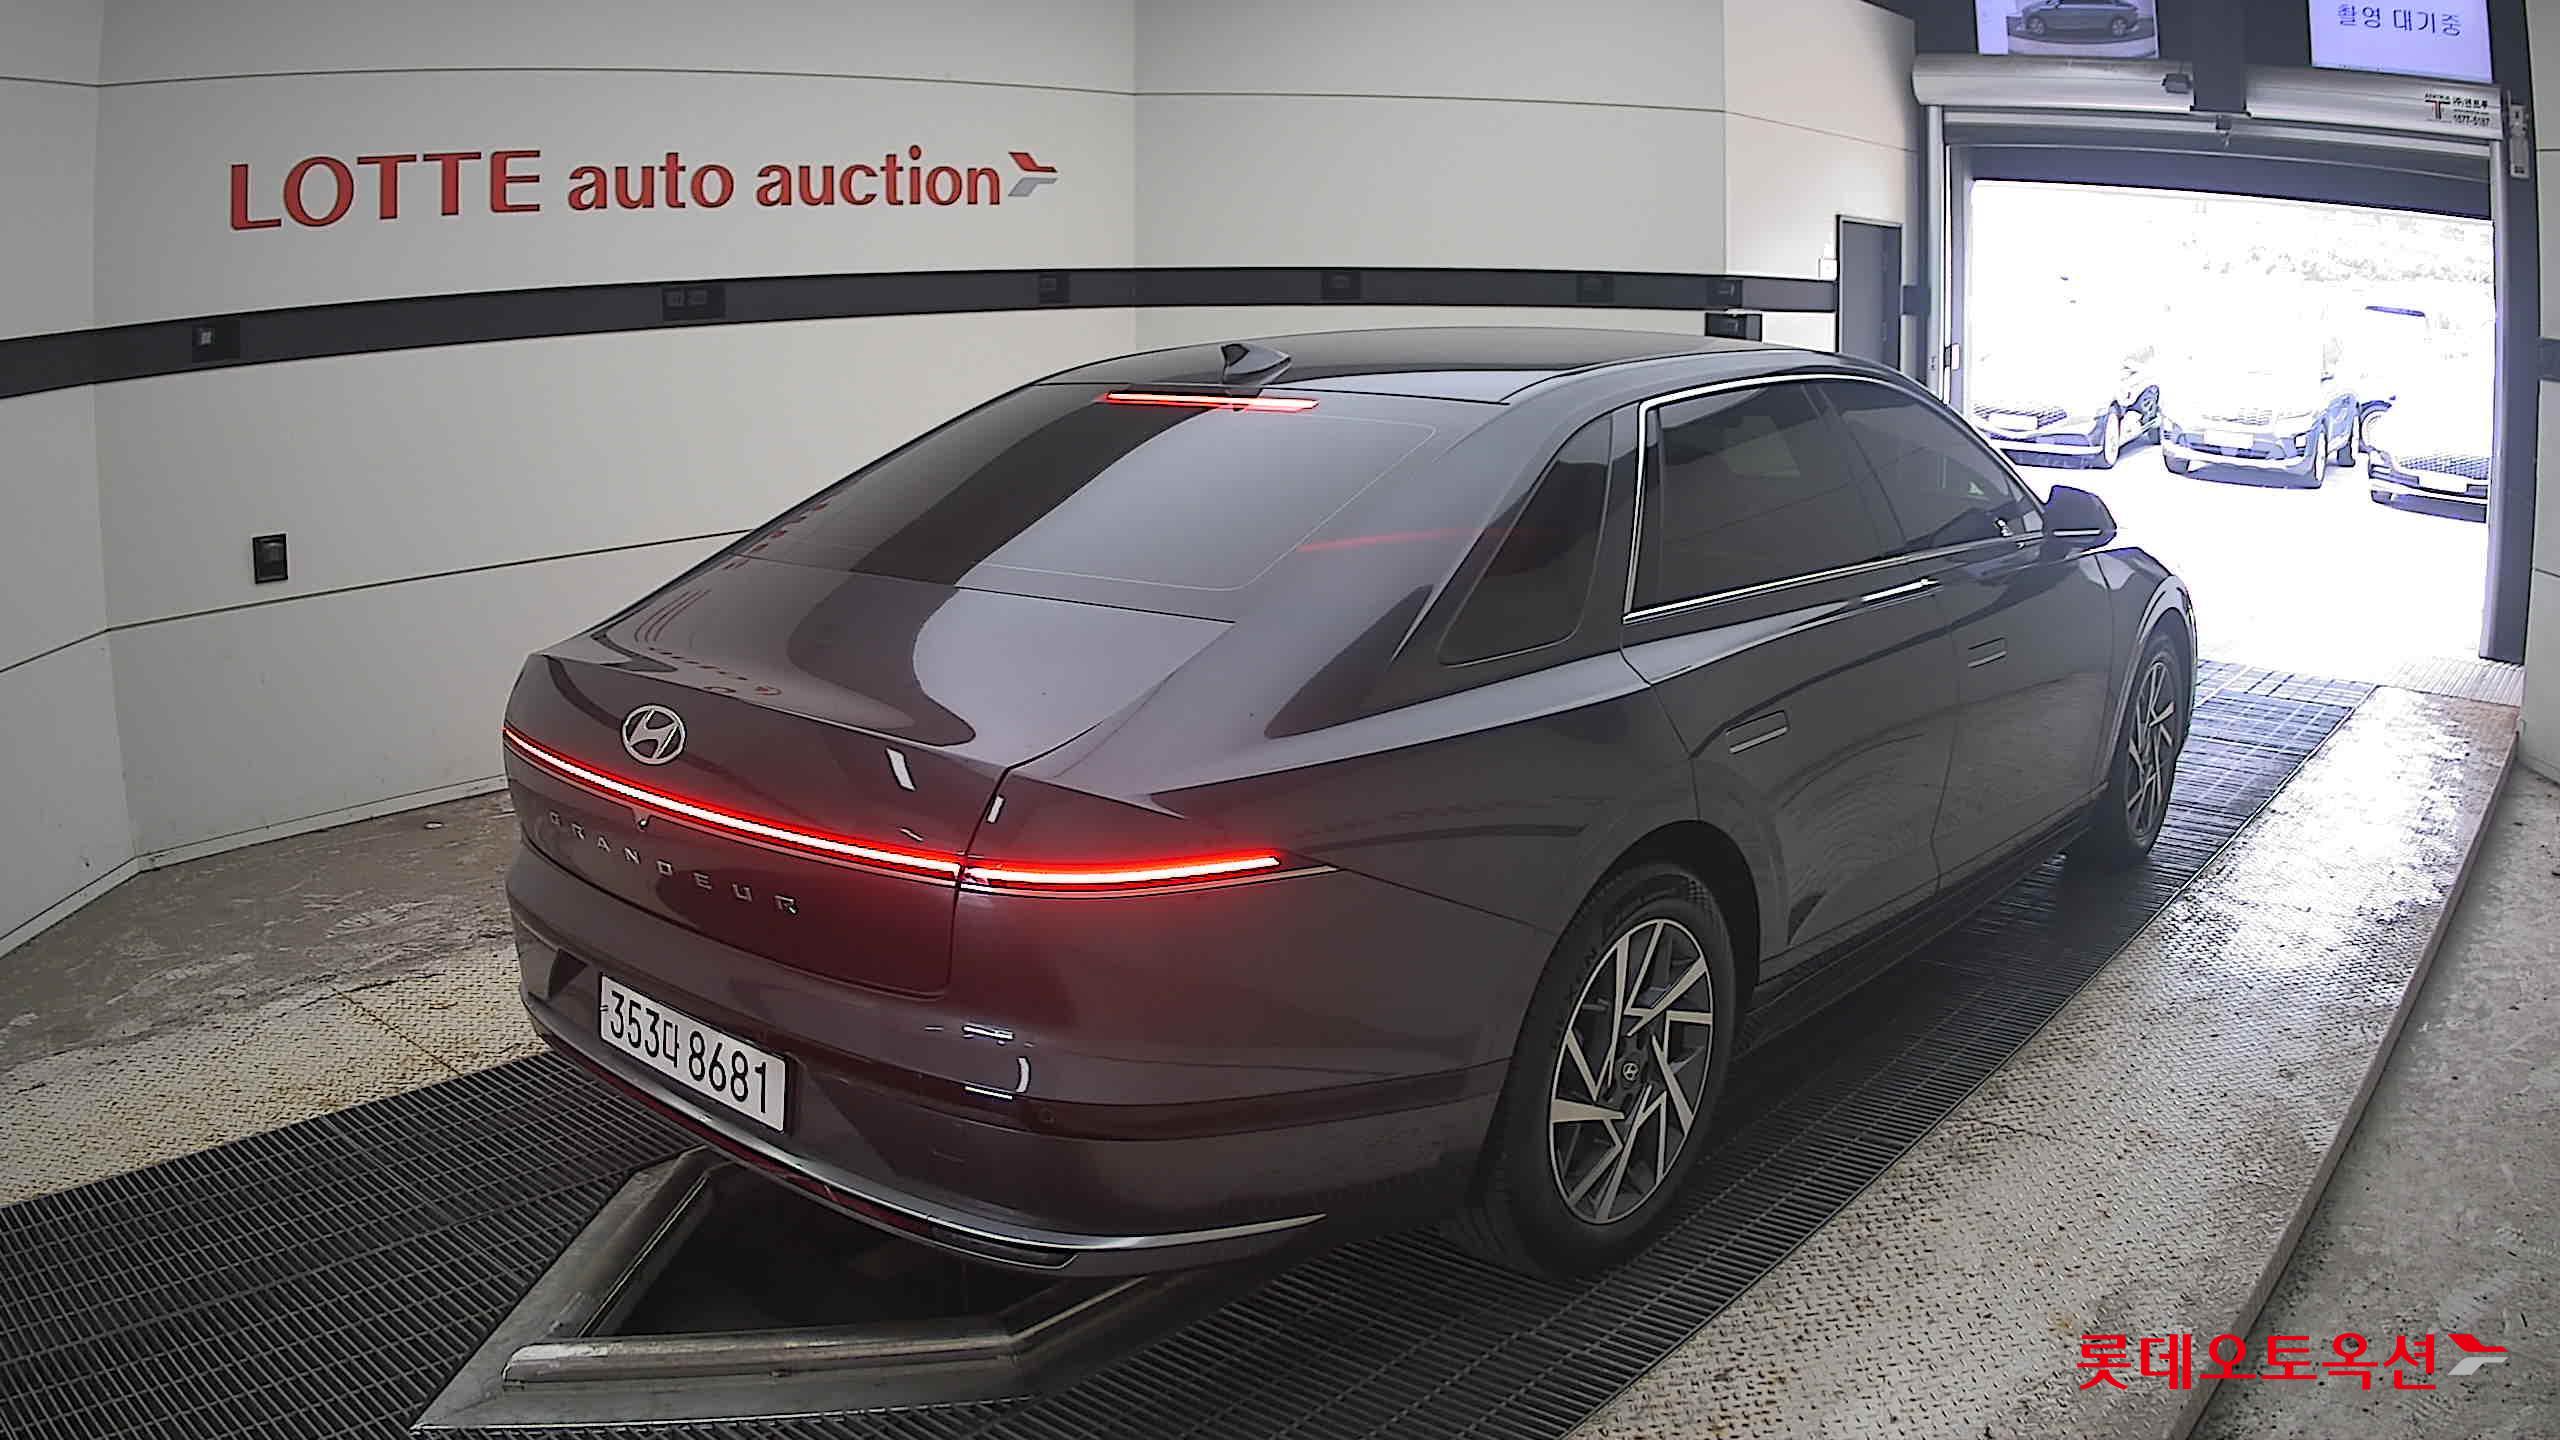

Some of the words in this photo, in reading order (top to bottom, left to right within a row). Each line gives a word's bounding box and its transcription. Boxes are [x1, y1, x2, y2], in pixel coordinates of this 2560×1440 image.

[2337, 4, 2381, 29] 촬영
[2393, 8, 2461, 37] 대기중
[230, 149, 541, 231] LOTTE
[567, 151, 735, 210] auto
[755, 144, 1001, 209] auction
[549, 810, 798, 915] GRANDEUR
[688, 1030, 768, 1114] 8681
